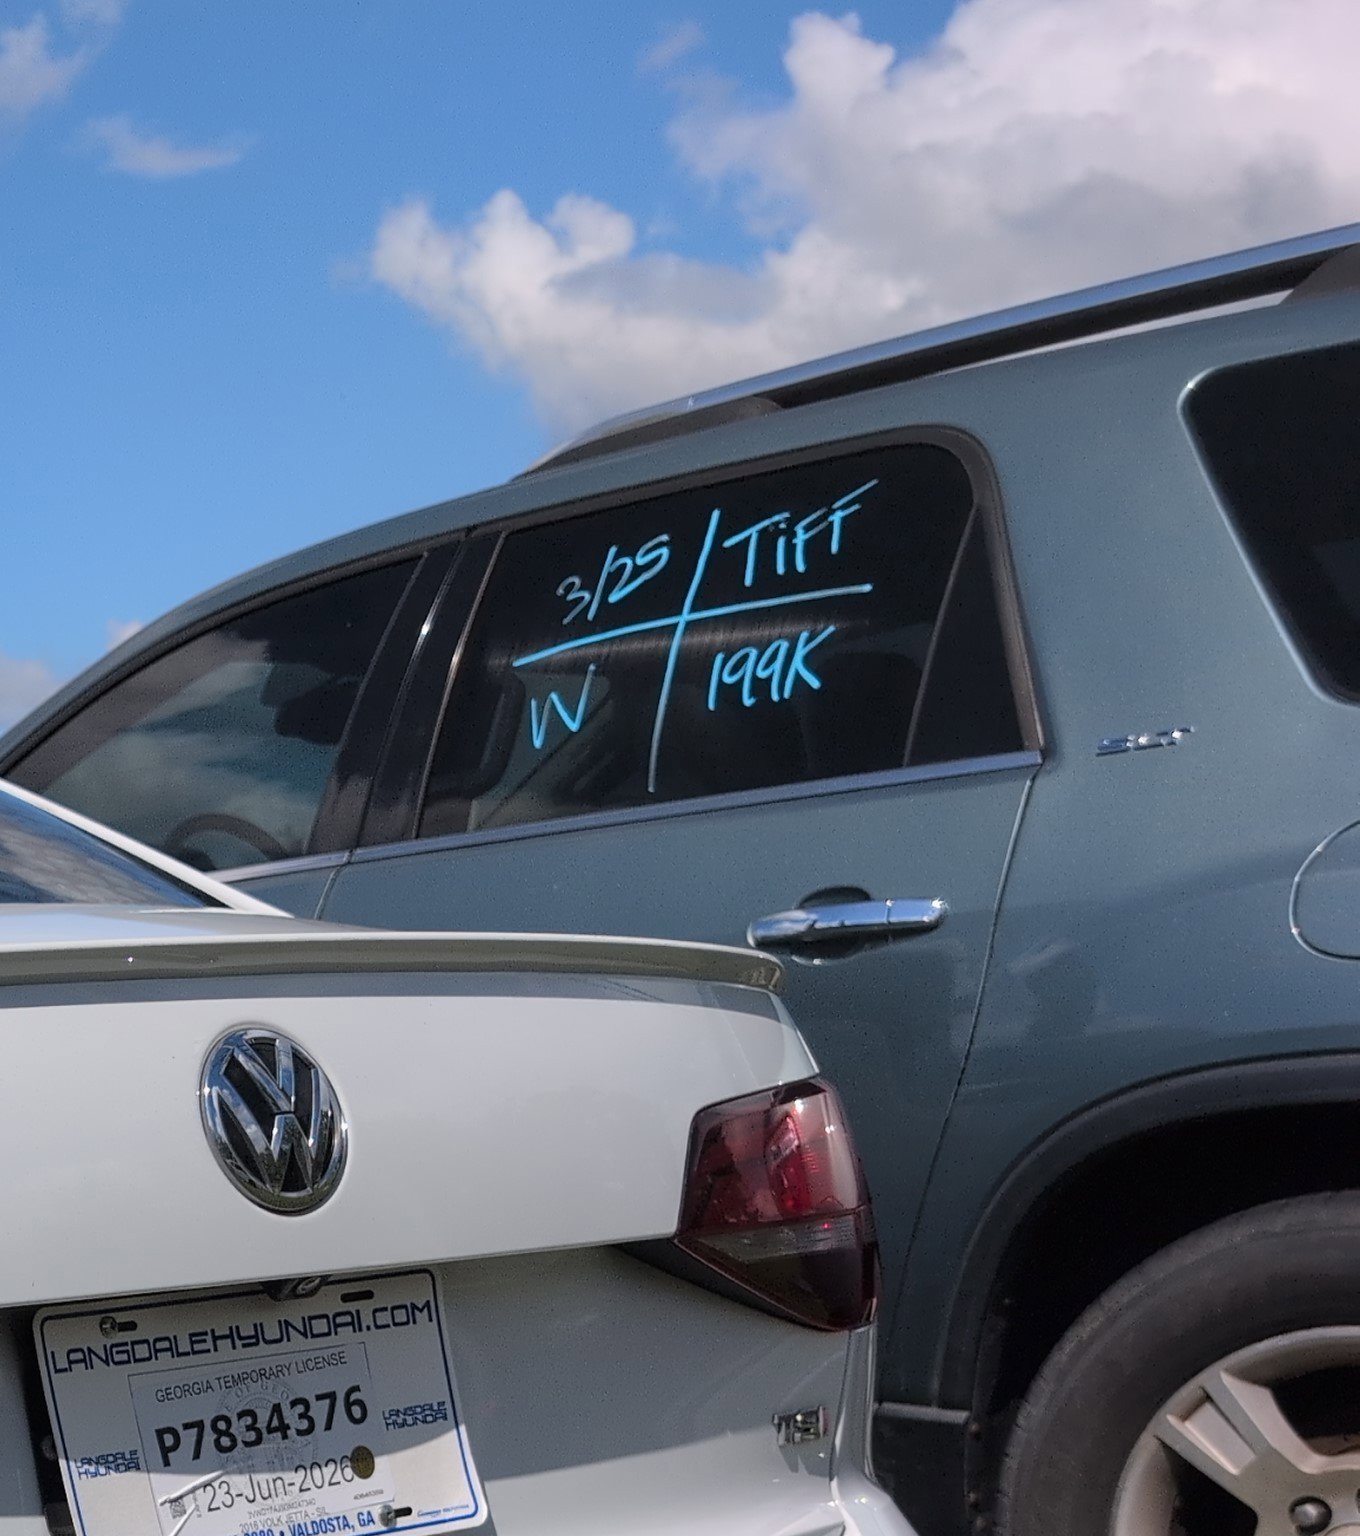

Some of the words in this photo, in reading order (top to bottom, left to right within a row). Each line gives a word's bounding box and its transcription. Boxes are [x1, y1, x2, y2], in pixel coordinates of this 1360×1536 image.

[557, 533, 671, 625] 3/25
[707, 626, 837, 711] 199K
[51, 1300, 434, 1374] LANGDALEHYUNDAI.COM
[155, 1379, 214, 1403] GEORGIA
[215, 1363, 293, 1392] TEMPORARY
[295, 1350, 347, 1375] LICENSE
[155, 1384, 368, 1467] P7834376
[382, 1401, 447, 1421] LANGDALE
[385, 1411, 448, 1431] HYUNDAI
[75, 1449, 140, 1468] LANGDALE
[77, 1460, 141, 1480] HYUNDAI
[202, 1455, 355, 1513] 23-Jun-2026
[357, 1510, 376, 1527] GA
